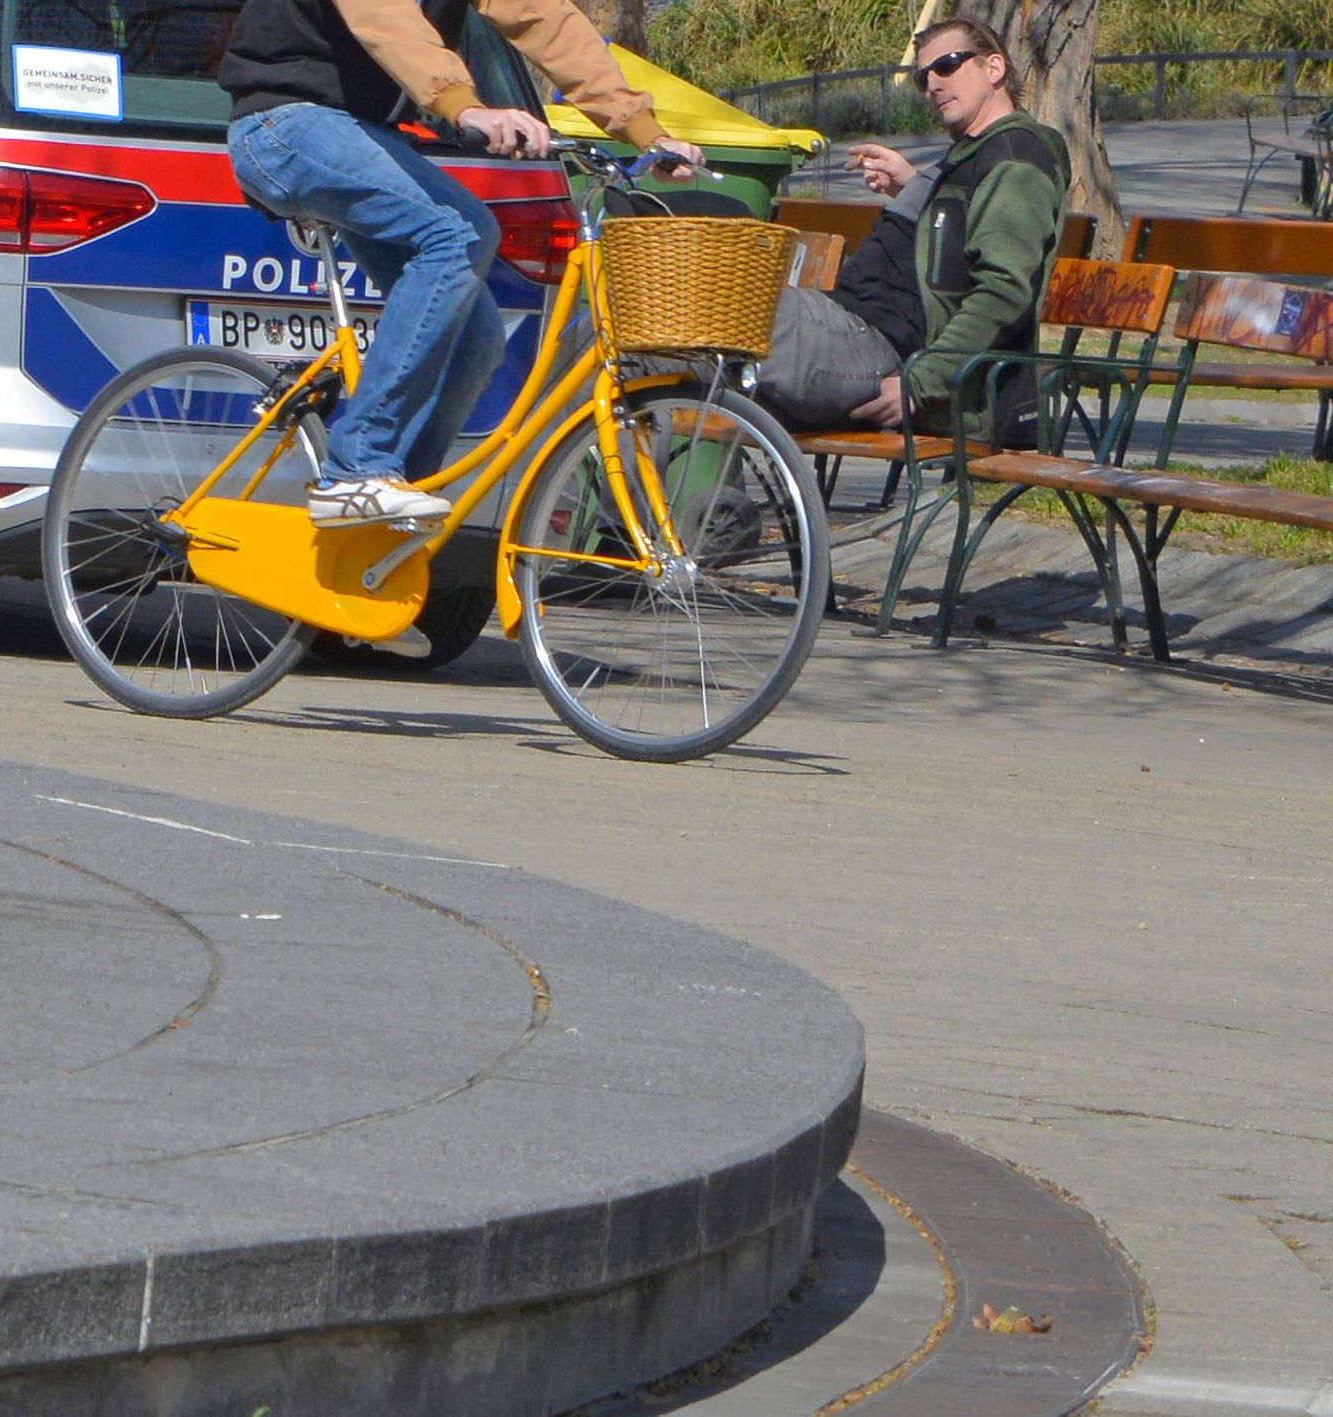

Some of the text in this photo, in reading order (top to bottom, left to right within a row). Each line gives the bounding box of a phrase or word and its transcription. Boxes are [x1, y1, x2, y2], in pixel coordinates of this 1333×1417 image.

[27, 80, 110, 96] mit unserer Polizei
[222, 255, 382, 298] POLIZ
[222, 311, 380, 354] BP 903
